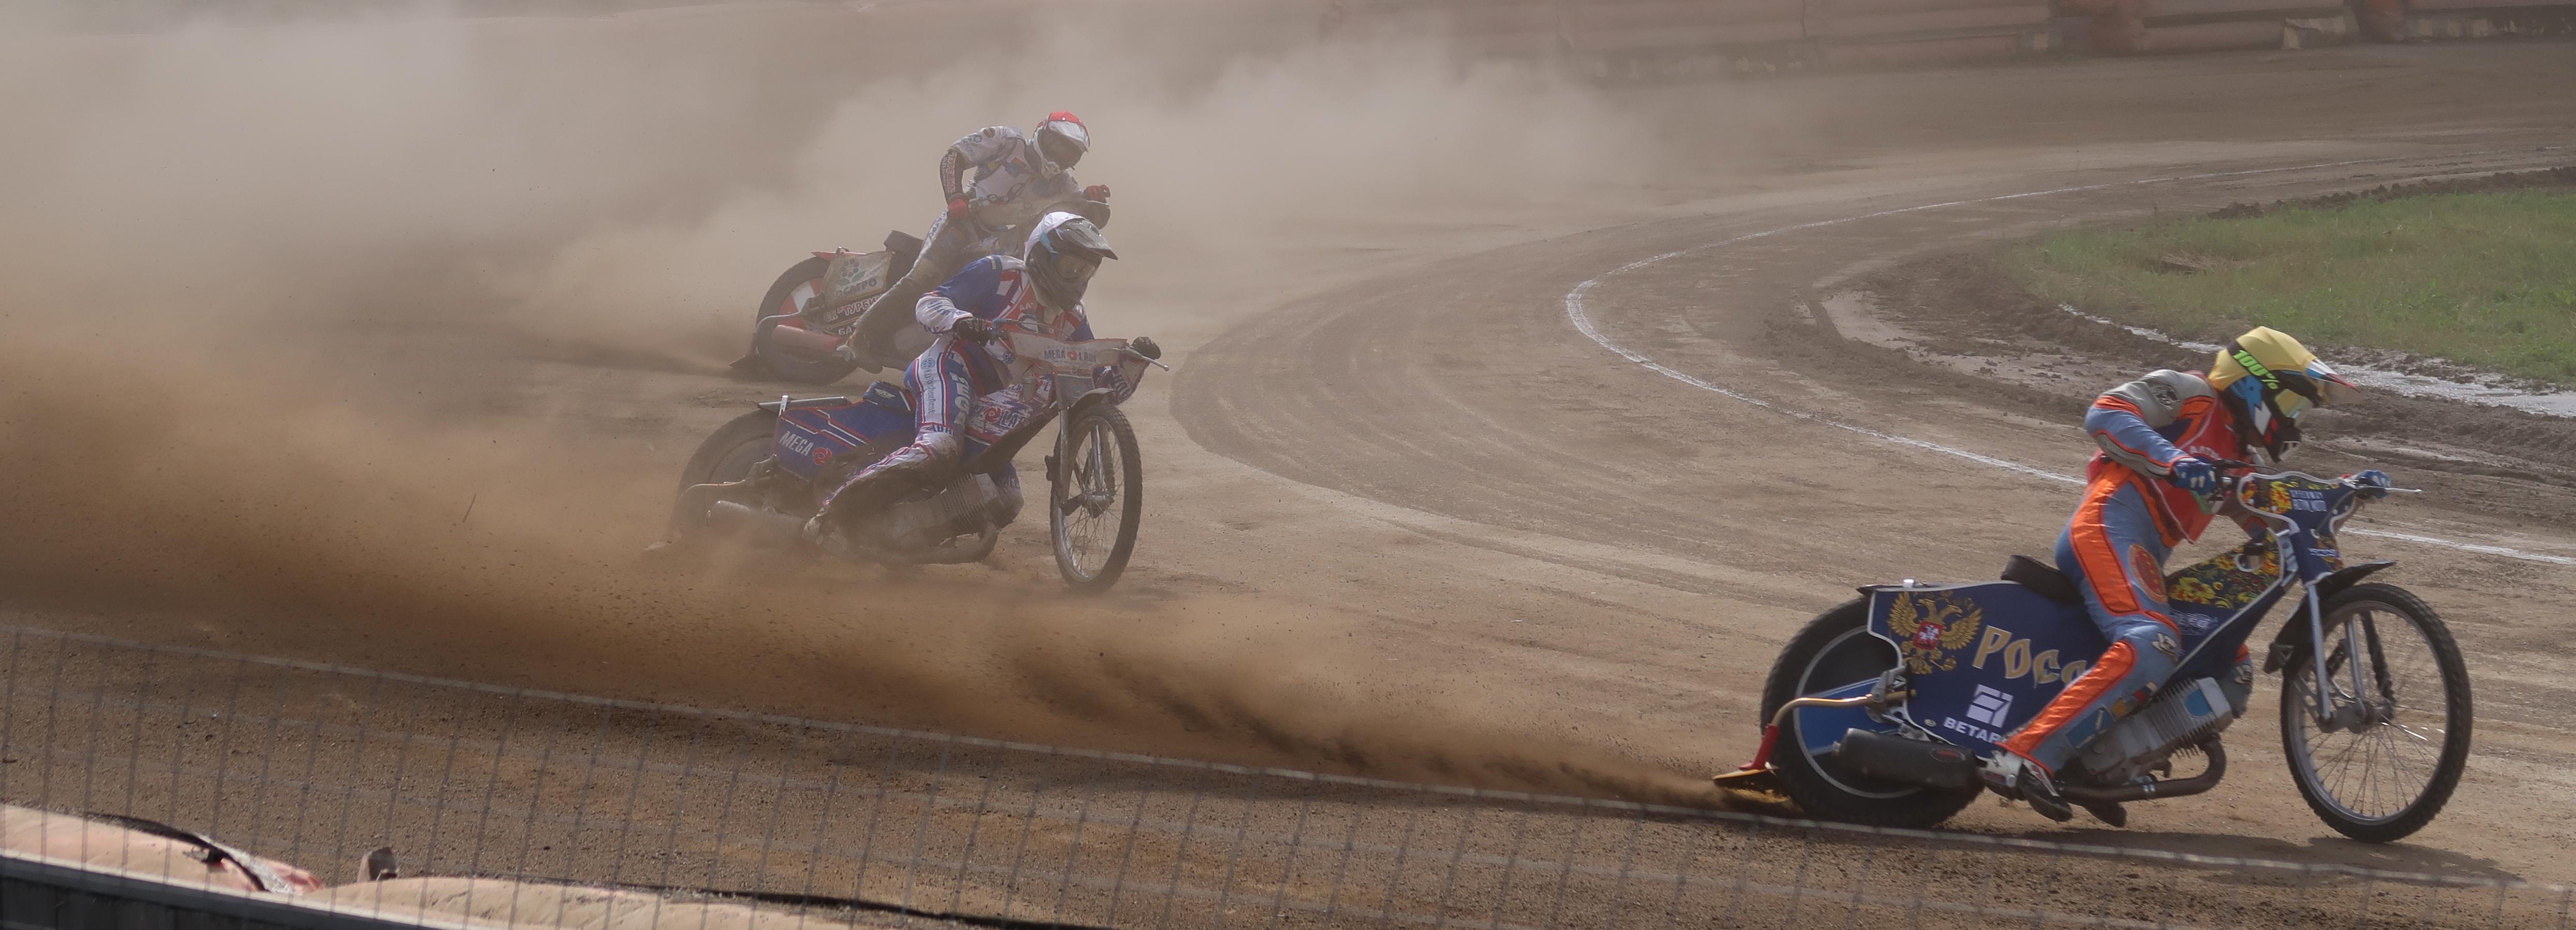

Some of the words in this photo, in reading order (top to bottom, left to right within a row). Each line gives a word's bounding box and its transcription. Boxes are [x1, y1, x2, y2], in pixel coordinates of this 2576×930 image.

[1044, 349, 1066, 359] MEGA
[2233, 350, 2280, 390] 100%
[780, 431, 814, 455] MEGA
